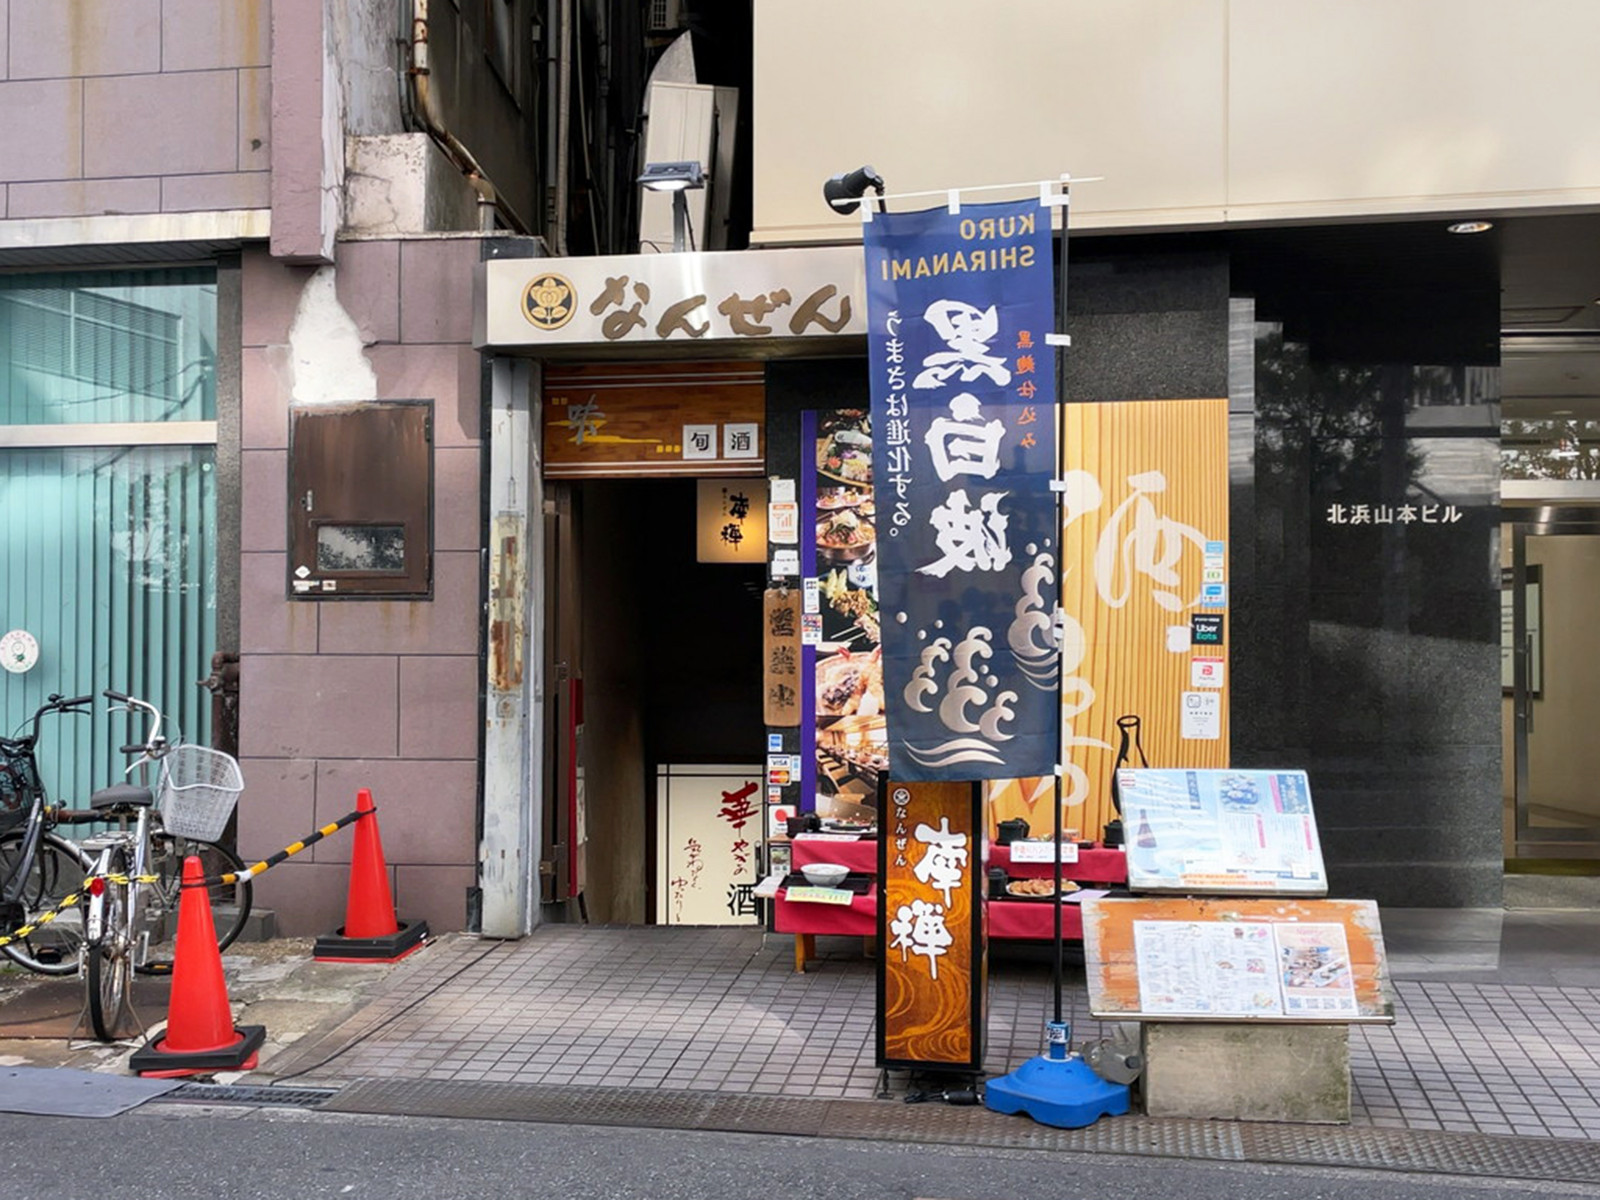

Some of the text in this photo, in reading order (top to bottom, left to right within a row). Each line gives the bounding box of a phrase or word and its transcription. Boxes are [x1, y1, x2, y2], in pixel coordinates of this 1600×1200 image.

[590, 275, 852, 340] なんぜん
[691, 431, 750, 451] 旬 酒
[1326, 503, 1463, 525] 北浜山本ビル
[1196, 624, 1218, 632] Uber
[895, 807, 908, 867] なんぜん
